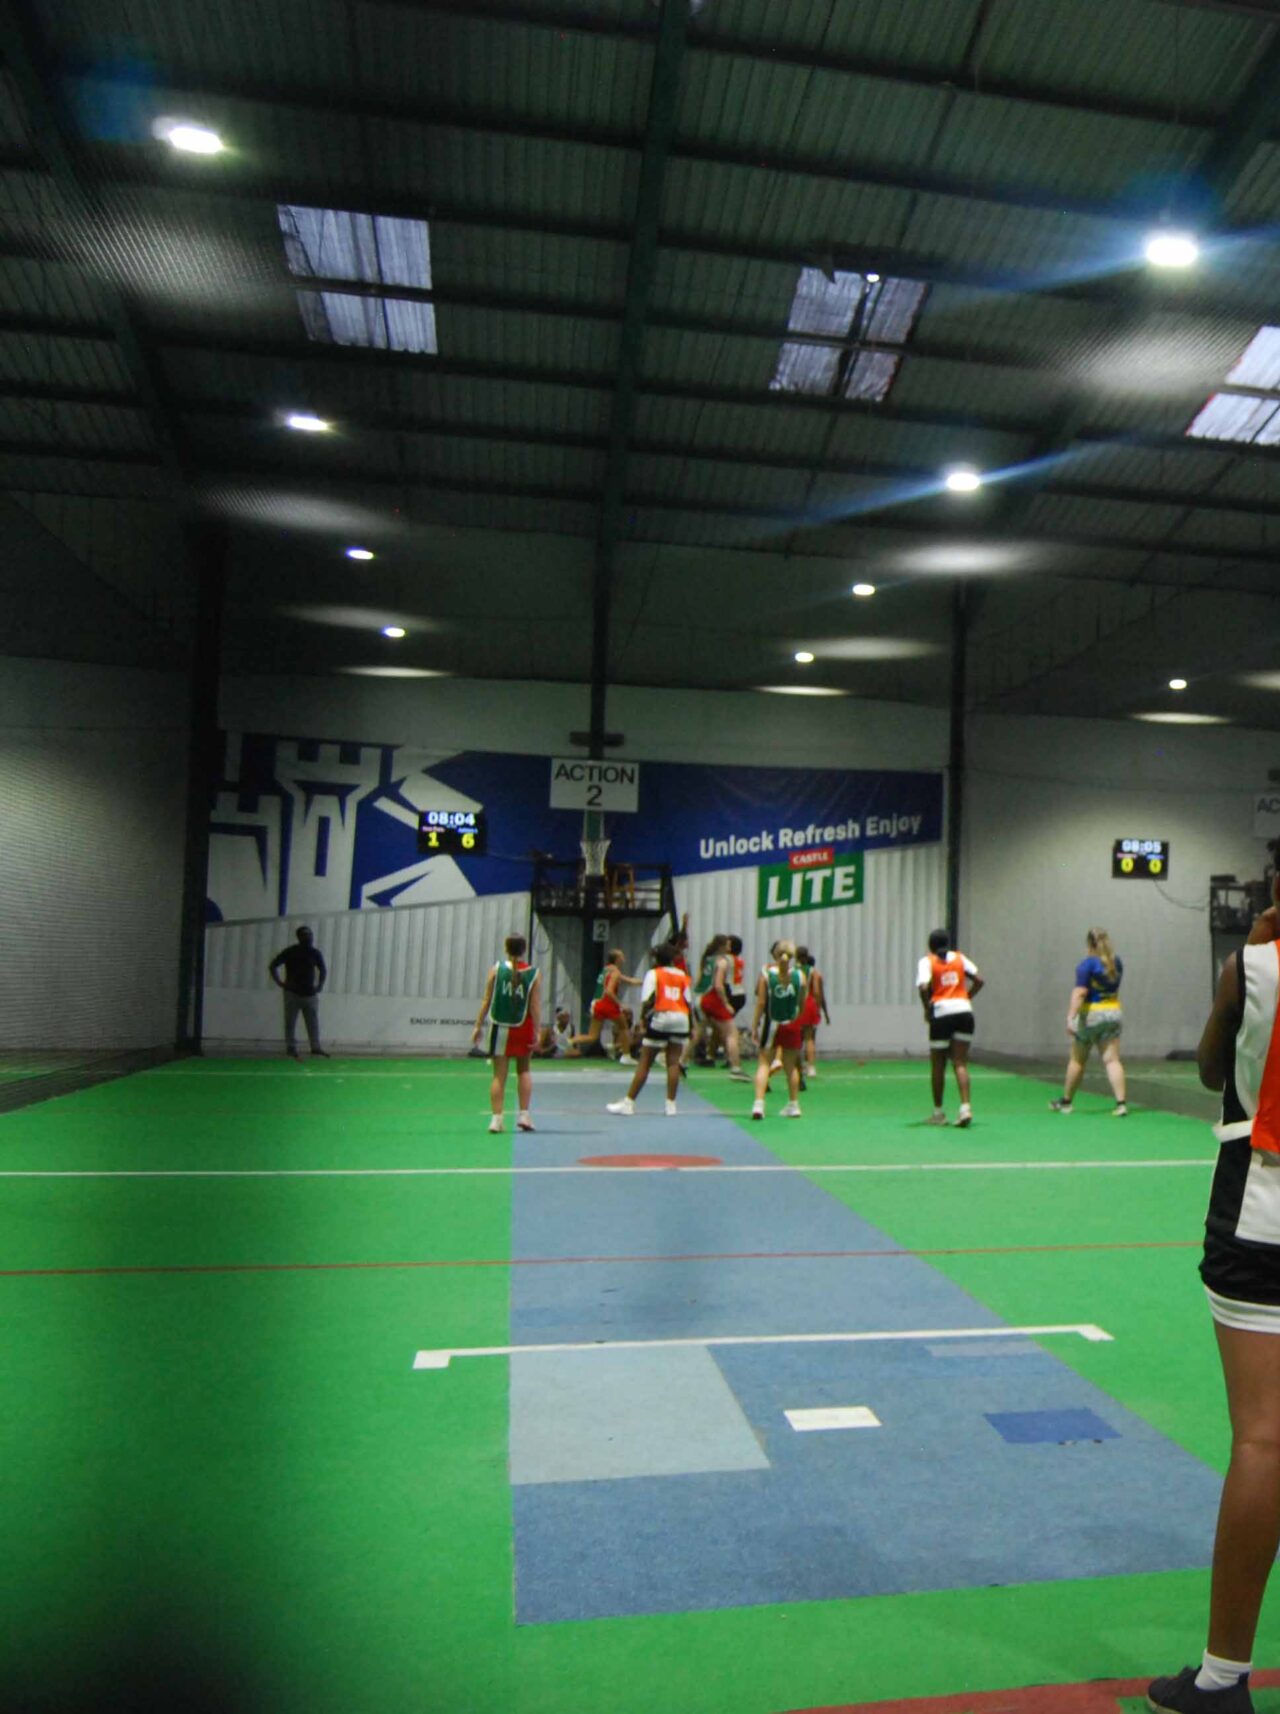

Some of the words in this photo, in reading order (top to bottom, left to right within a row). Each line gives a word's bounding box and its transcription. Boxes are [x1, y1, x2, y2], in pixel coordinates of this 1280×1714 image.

[554, 763, 635, 784] ACTION
[586, 785, 602, 807] 2
[427, 811, 475, 827] 08:04
[428, 832, 439, 848] 1
[461, 832, 475, 849] 6
[700, 830, 774, 859] Unlock
[779, 818, 860, 849] Refresh
[865, 813, 922, 838] Enjoy
[792, 851, 829, 866] CASTLE
[1121, 858, 1134, 873] 0
[1149, 859, 1162, 874] 0
[766, 865, 856, 911] LITE
[774, 983, 796, 999] GA
